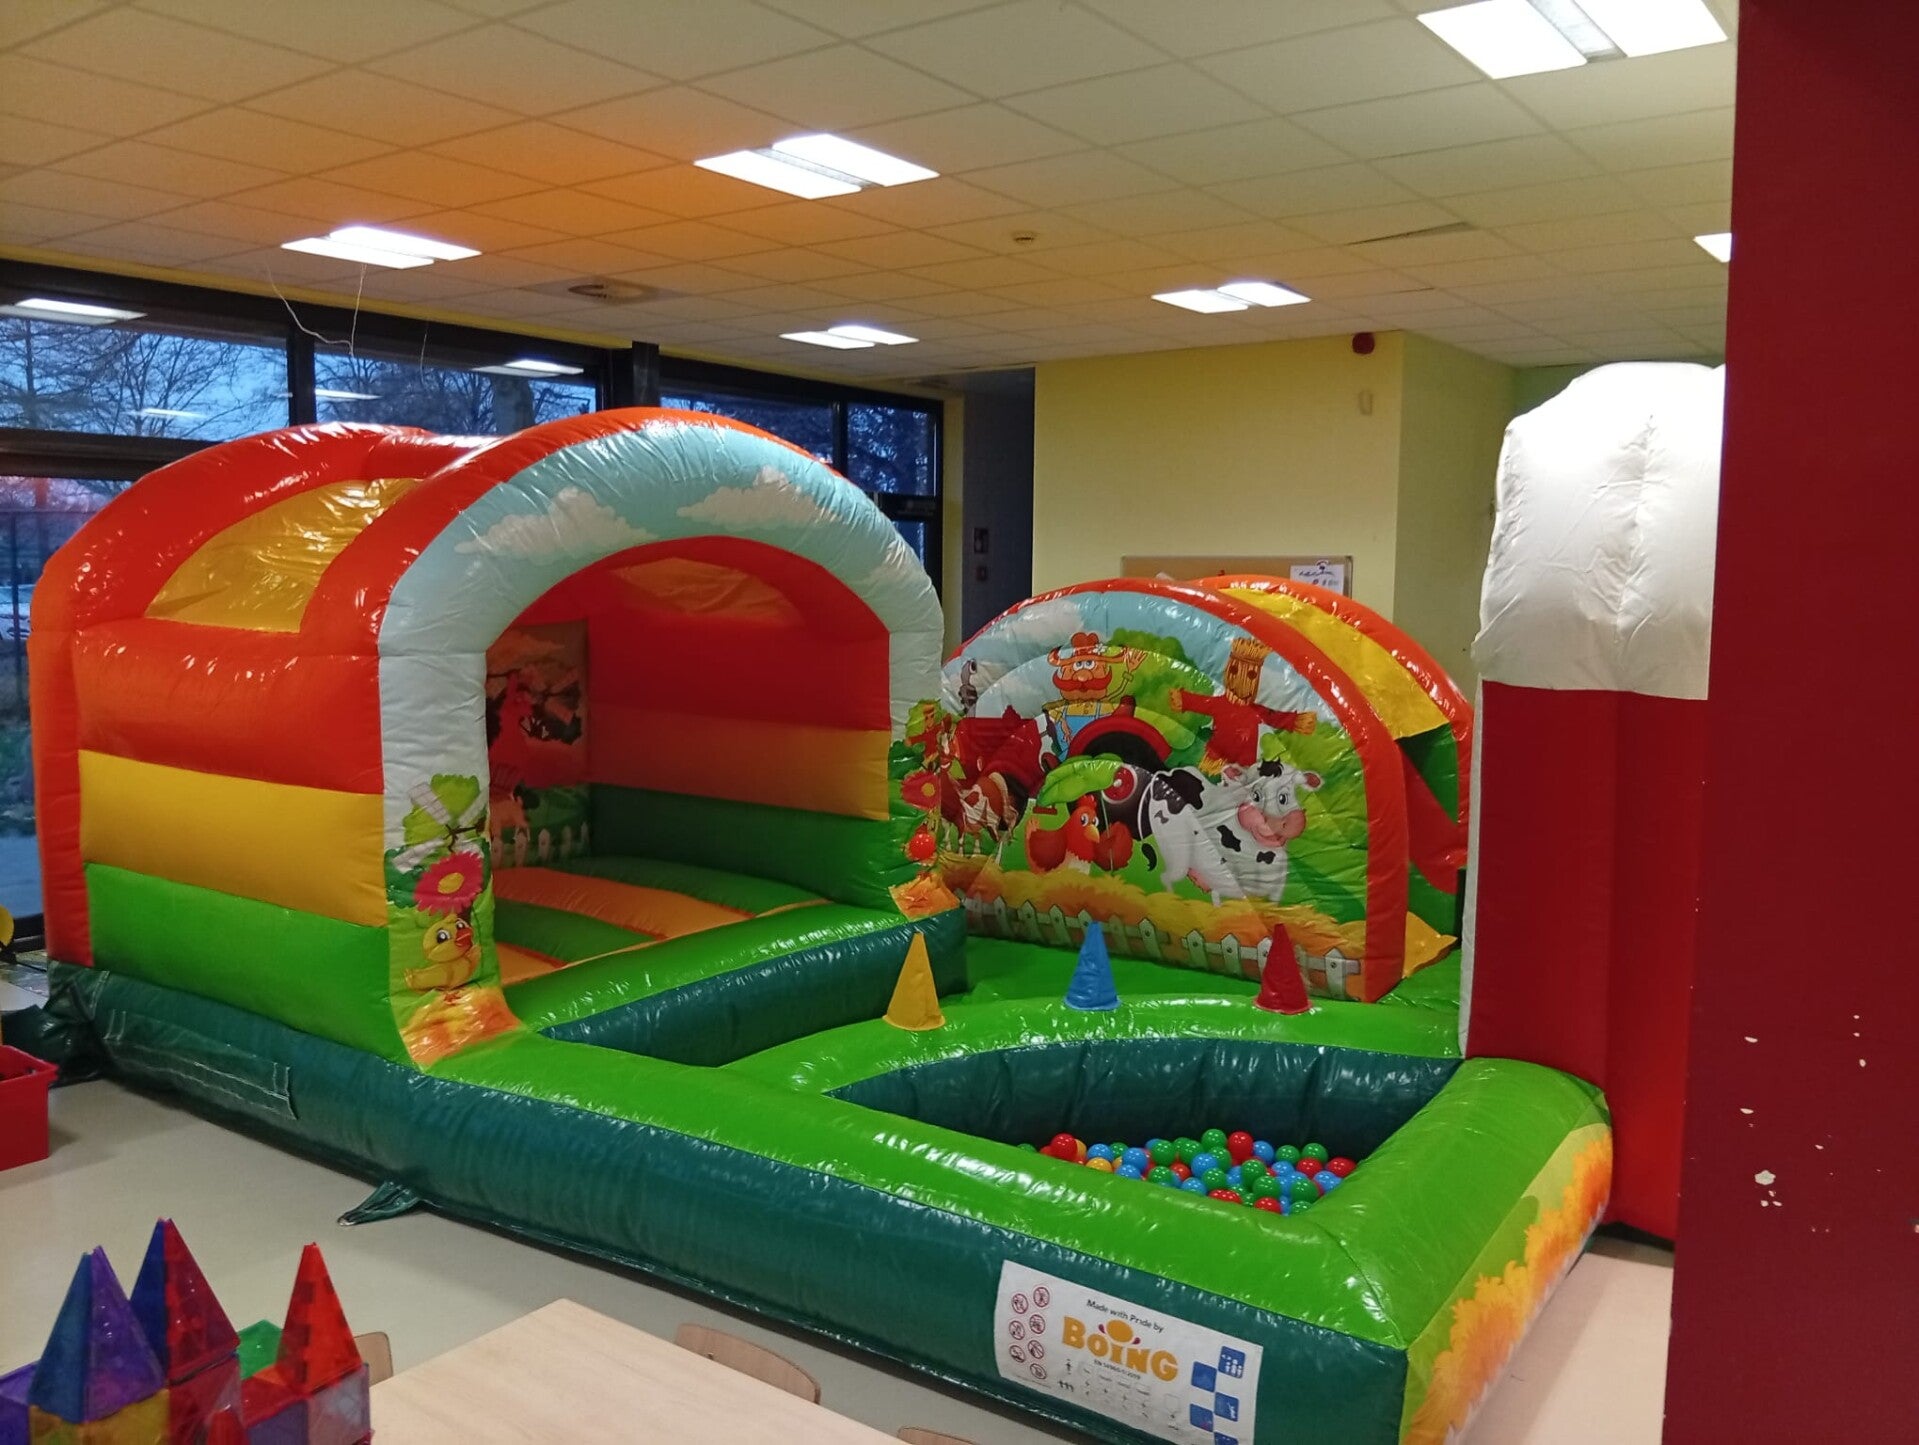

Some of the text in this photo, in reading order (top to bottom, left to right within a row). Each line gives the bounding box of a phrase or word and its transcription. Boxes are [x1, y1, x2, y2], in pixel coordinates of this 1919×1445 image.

[1086, 1299, 1165, 1333] Made with Pride by
[1062, 1316, 1178, 1382] BOING
